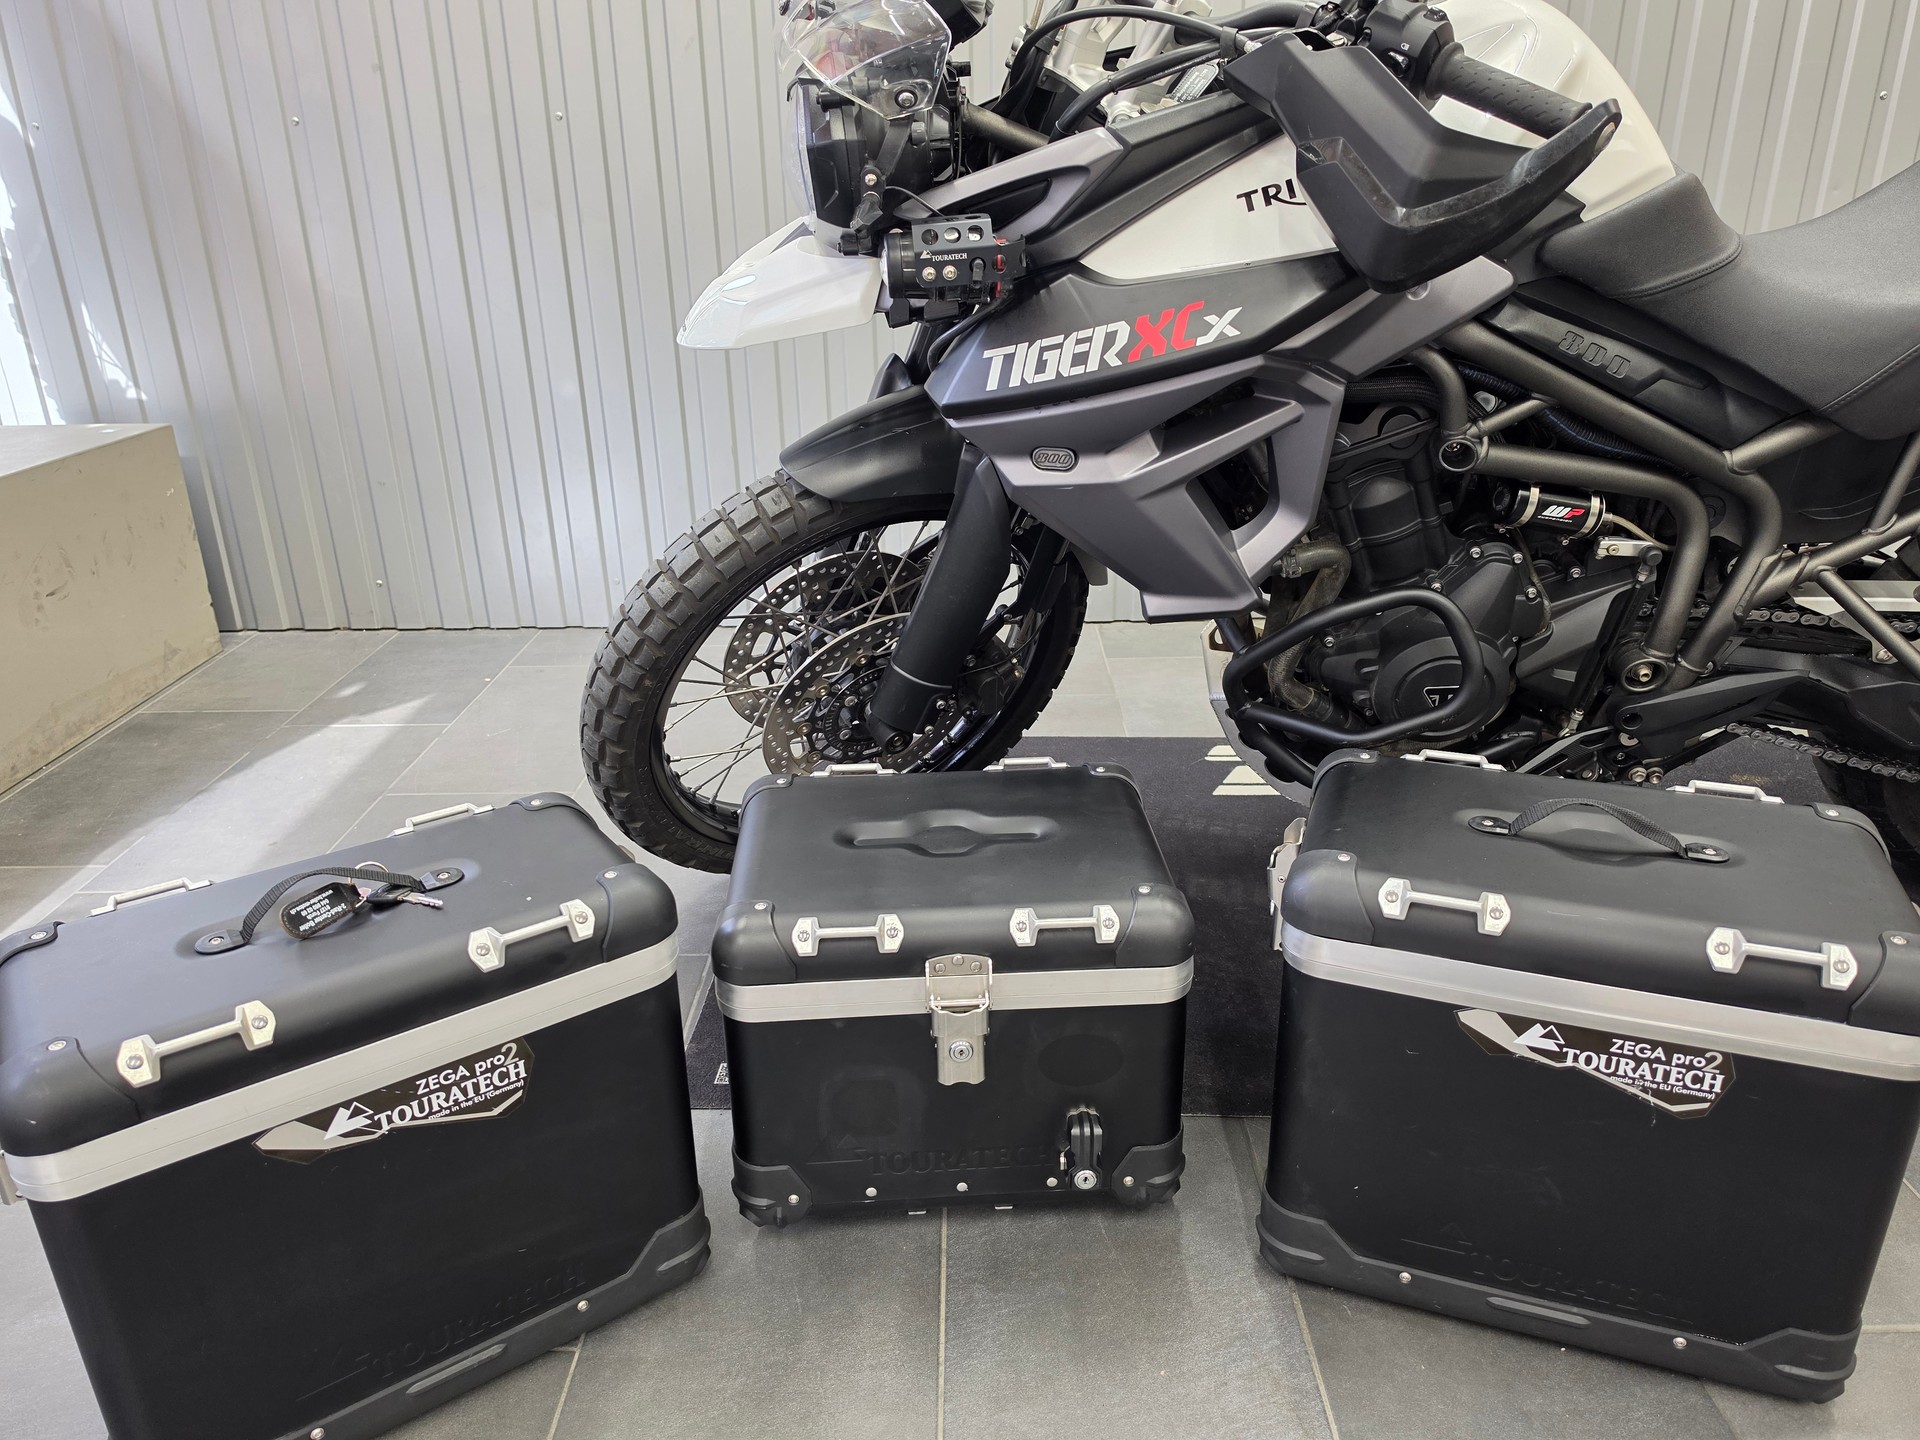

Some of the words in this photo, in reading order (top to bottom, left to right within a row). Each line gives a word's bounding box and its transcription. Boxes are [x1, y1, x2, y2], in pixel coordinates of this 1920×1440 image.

[931, 252, 968, 262] TOURATECH
[1558, 330, 1632, 379] 800
[1037, 452, 1071, 465] 800
[1541, 505, 1586, 519] WP
[1609, 1038, 1666, 1061] ZEGA
[416, 1065, 471, 1095] ZEGA
[1562, 1047, 1725, 1093] TOURATECH
[374, 1059, 528, 1131] TOURATECH
[428, 1109, 451, 1120] made
[451, 1104, 460, 1113] in
[460, 1099, 473, 1109] the
[474, 1094, 485, 1104] EU
[485, 1079, 525, 1101] (Germany)
[1610, 1075, 1633, 1085] made
[1644, 1081, 1658, 1089] the
[1659, 1083, 1672, 1092] EU
[1672, 1086, 1716, 1100] (Germany)
